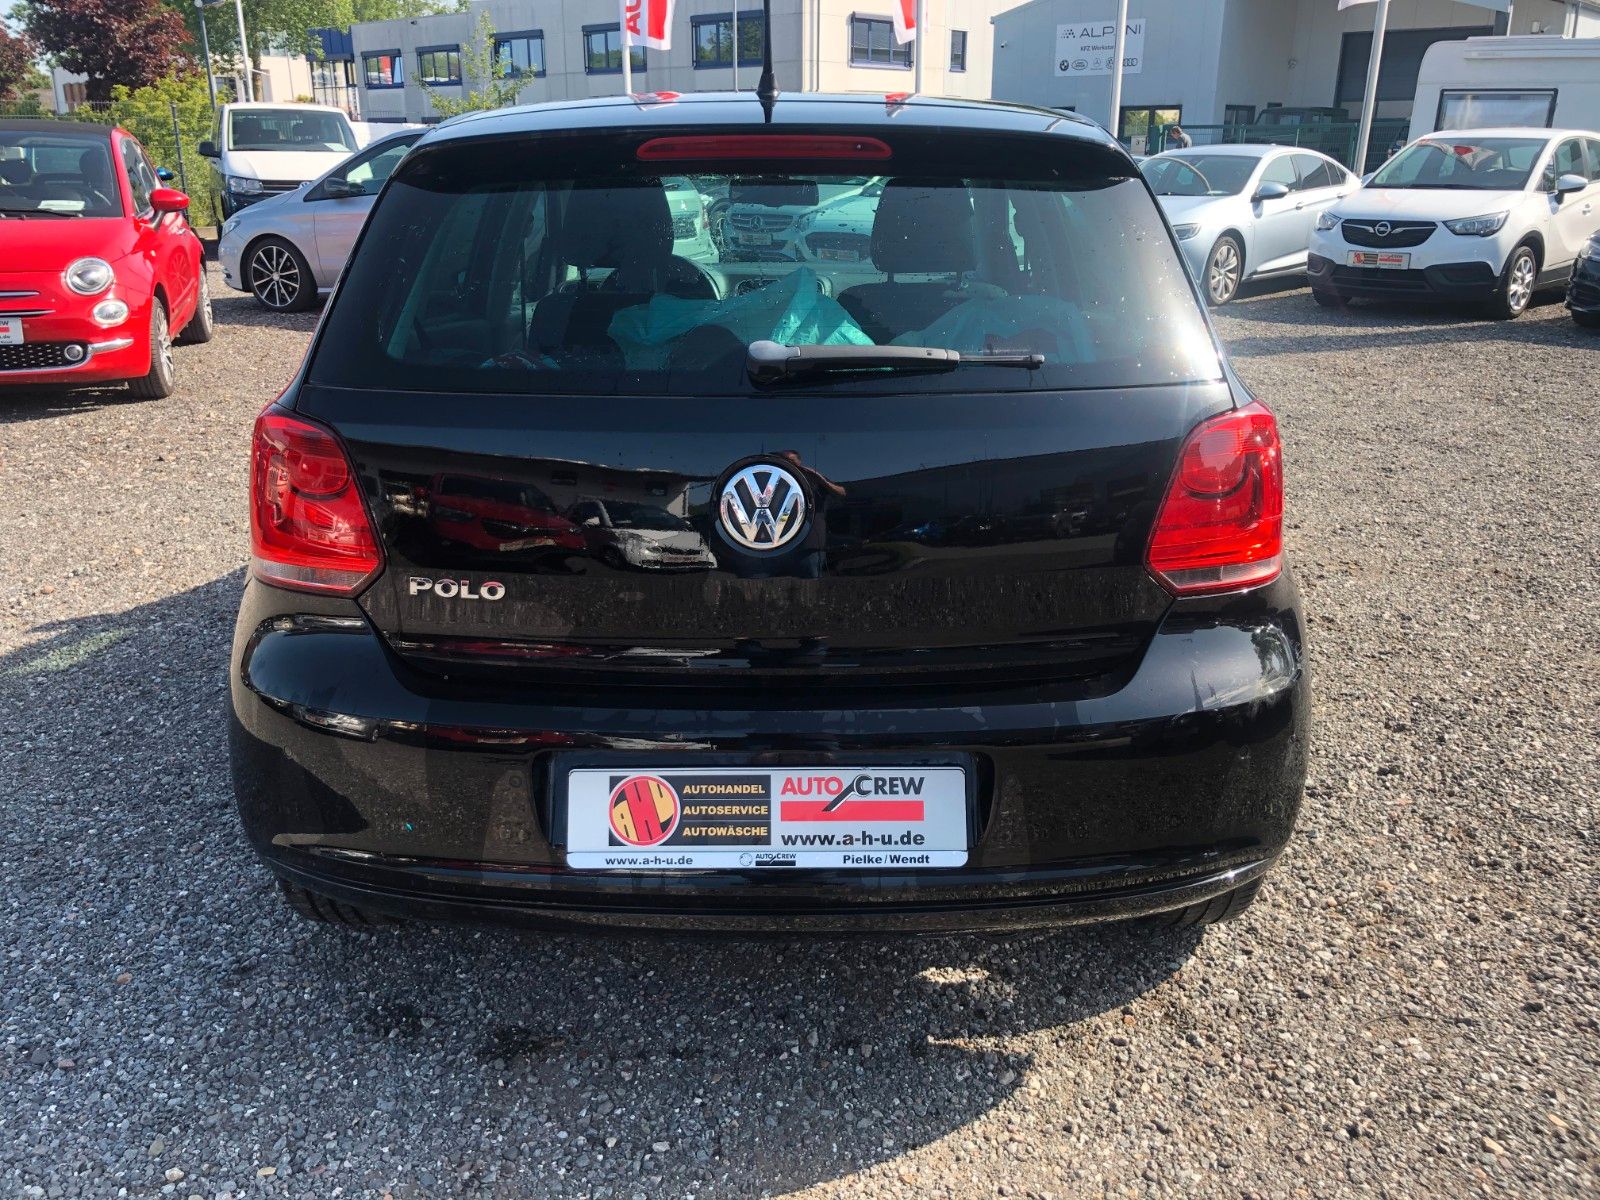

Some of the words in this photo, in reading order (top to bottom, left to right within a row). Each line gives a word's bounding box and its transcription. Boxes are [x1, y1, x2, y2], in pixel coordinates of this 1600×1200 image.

[1079, 25, 1141, 38] ALPNI
[1091, 44, 1115, 52] Werksta
[409, 576, 506, 600] POLO
[683, 784, 766, 794] AUTOHANDEL
[781, 776, 844, 796] AUTO
[683, 805, 768, 815] AUTOSERVICE
[683, 825, 768, 836] AUTOWÄSCHE
[781, 830, 925, 846] www.a-h-u.de
[605, 855, 693, 865] www.a-h-u.de
